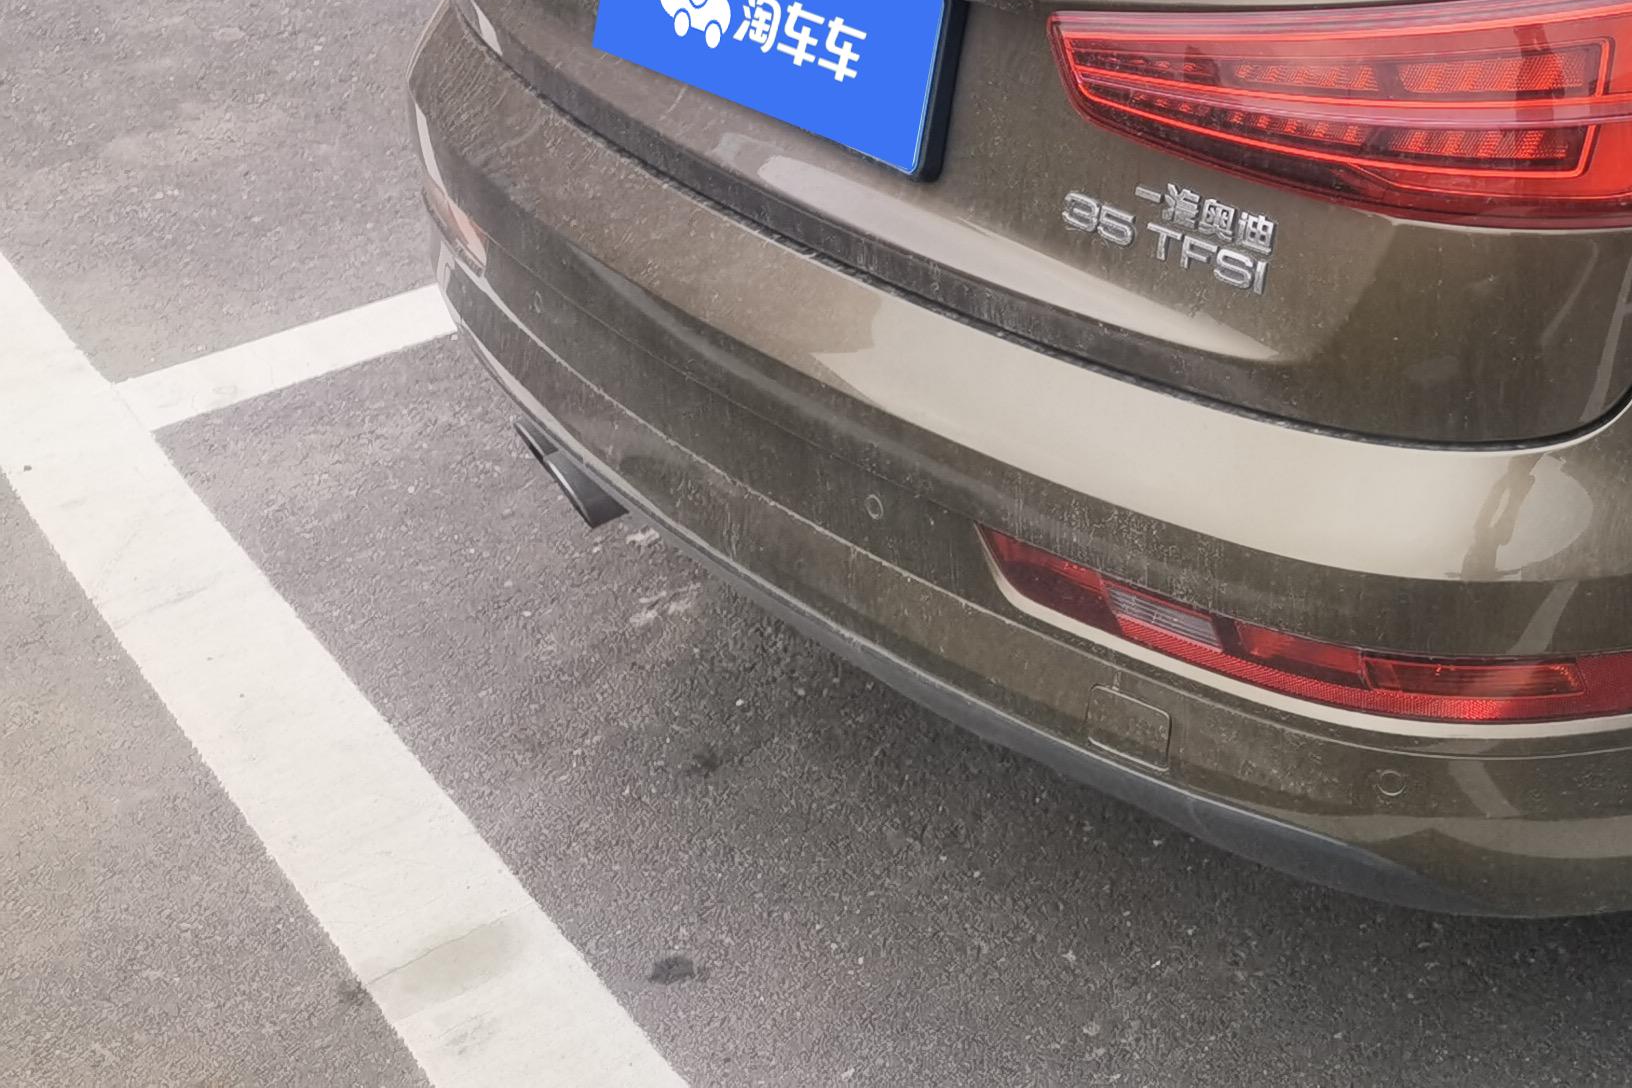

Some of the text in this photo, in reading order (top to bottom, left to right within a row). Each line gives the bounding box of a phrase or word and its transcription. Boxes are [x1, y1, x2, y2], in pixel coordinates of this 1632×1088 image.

[1061, 191, 1269, 295] 35 TFSI
[1134, 182, 1276, 255] 一汽奥迪
